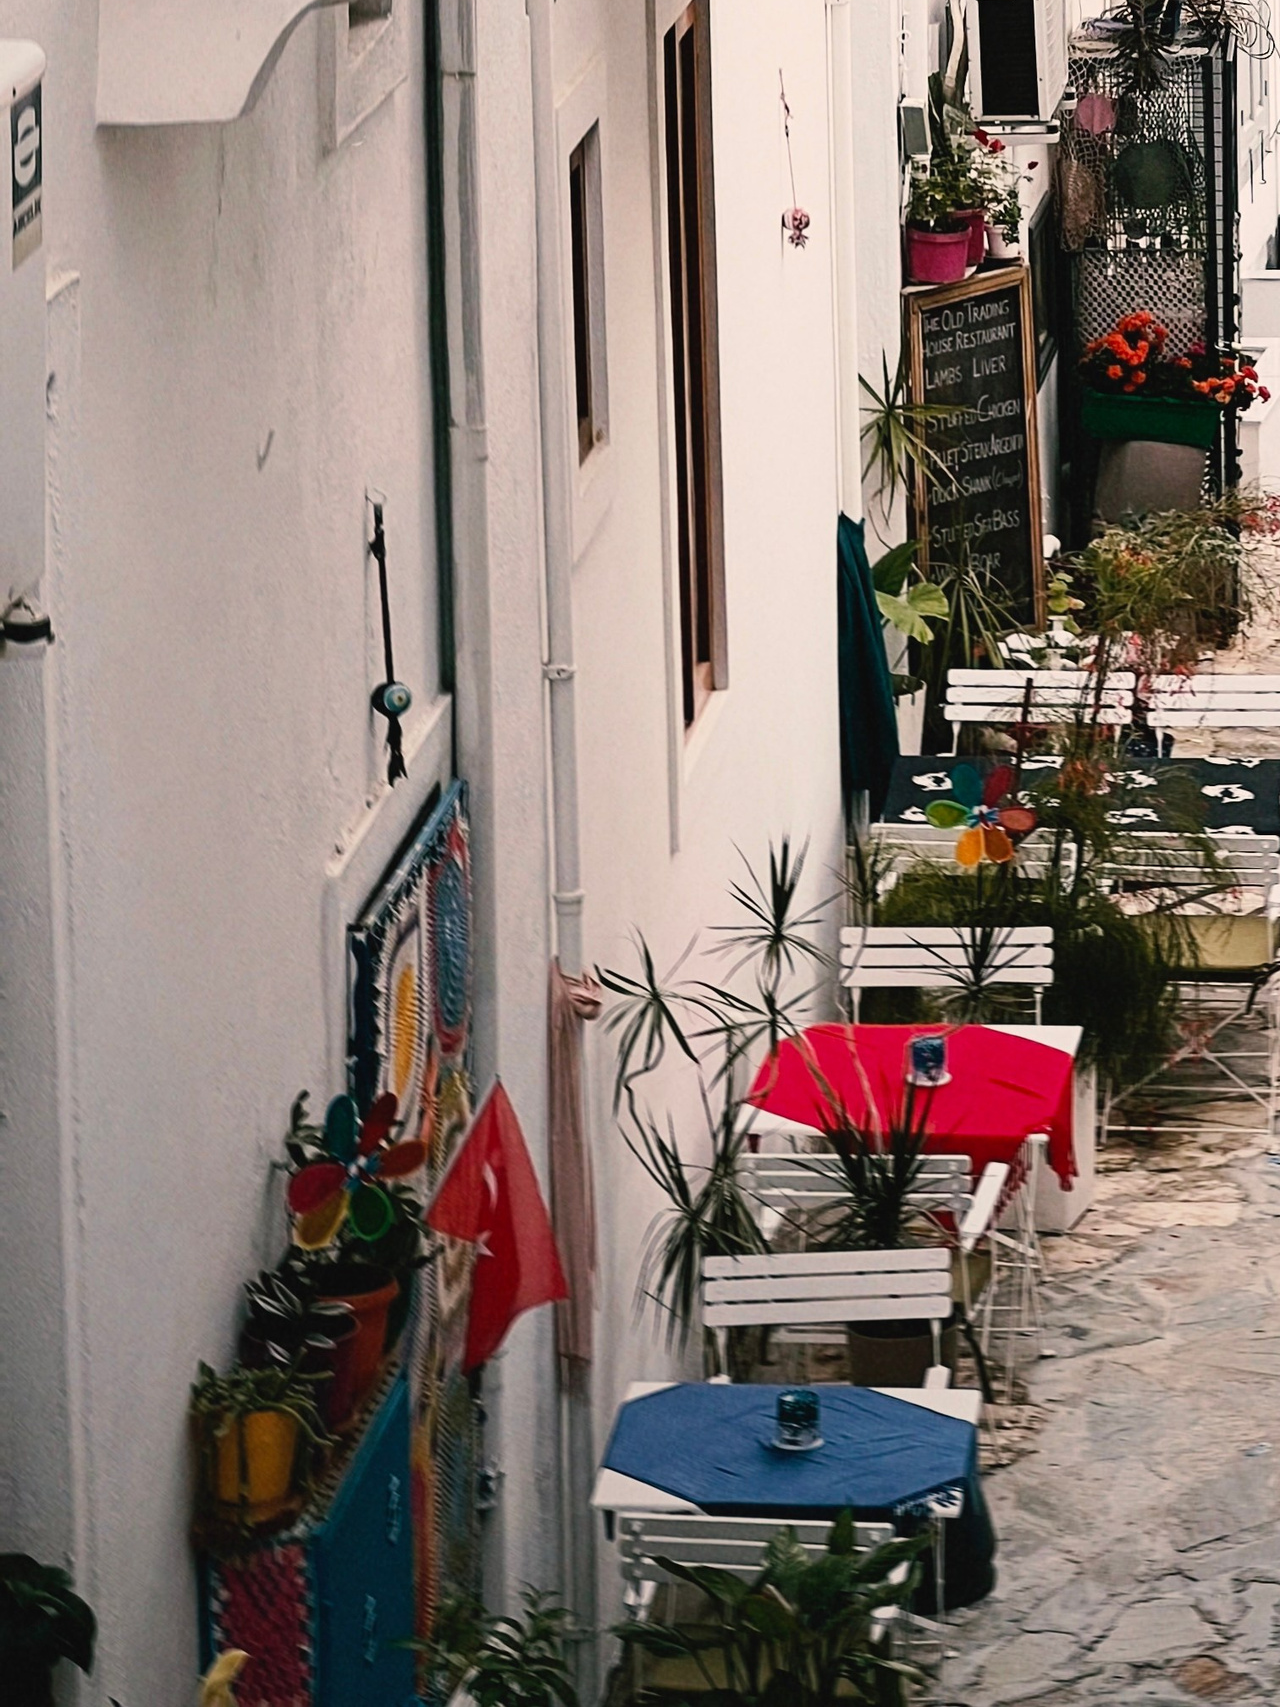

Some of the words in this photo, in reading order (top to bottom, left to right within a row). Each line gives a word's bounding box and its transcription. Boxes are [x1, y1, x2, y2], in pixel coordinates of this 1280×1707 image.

[923, 313, 941, 332] THE
[942, 309, 965, 331] OLD
[963, 299, 1010, 323] TRADING
[955, 322, 1016, 351] RESTAURANT
[925, 365, 963, 390] LAMBS
[972, 354, 1006, 378] LIVER
